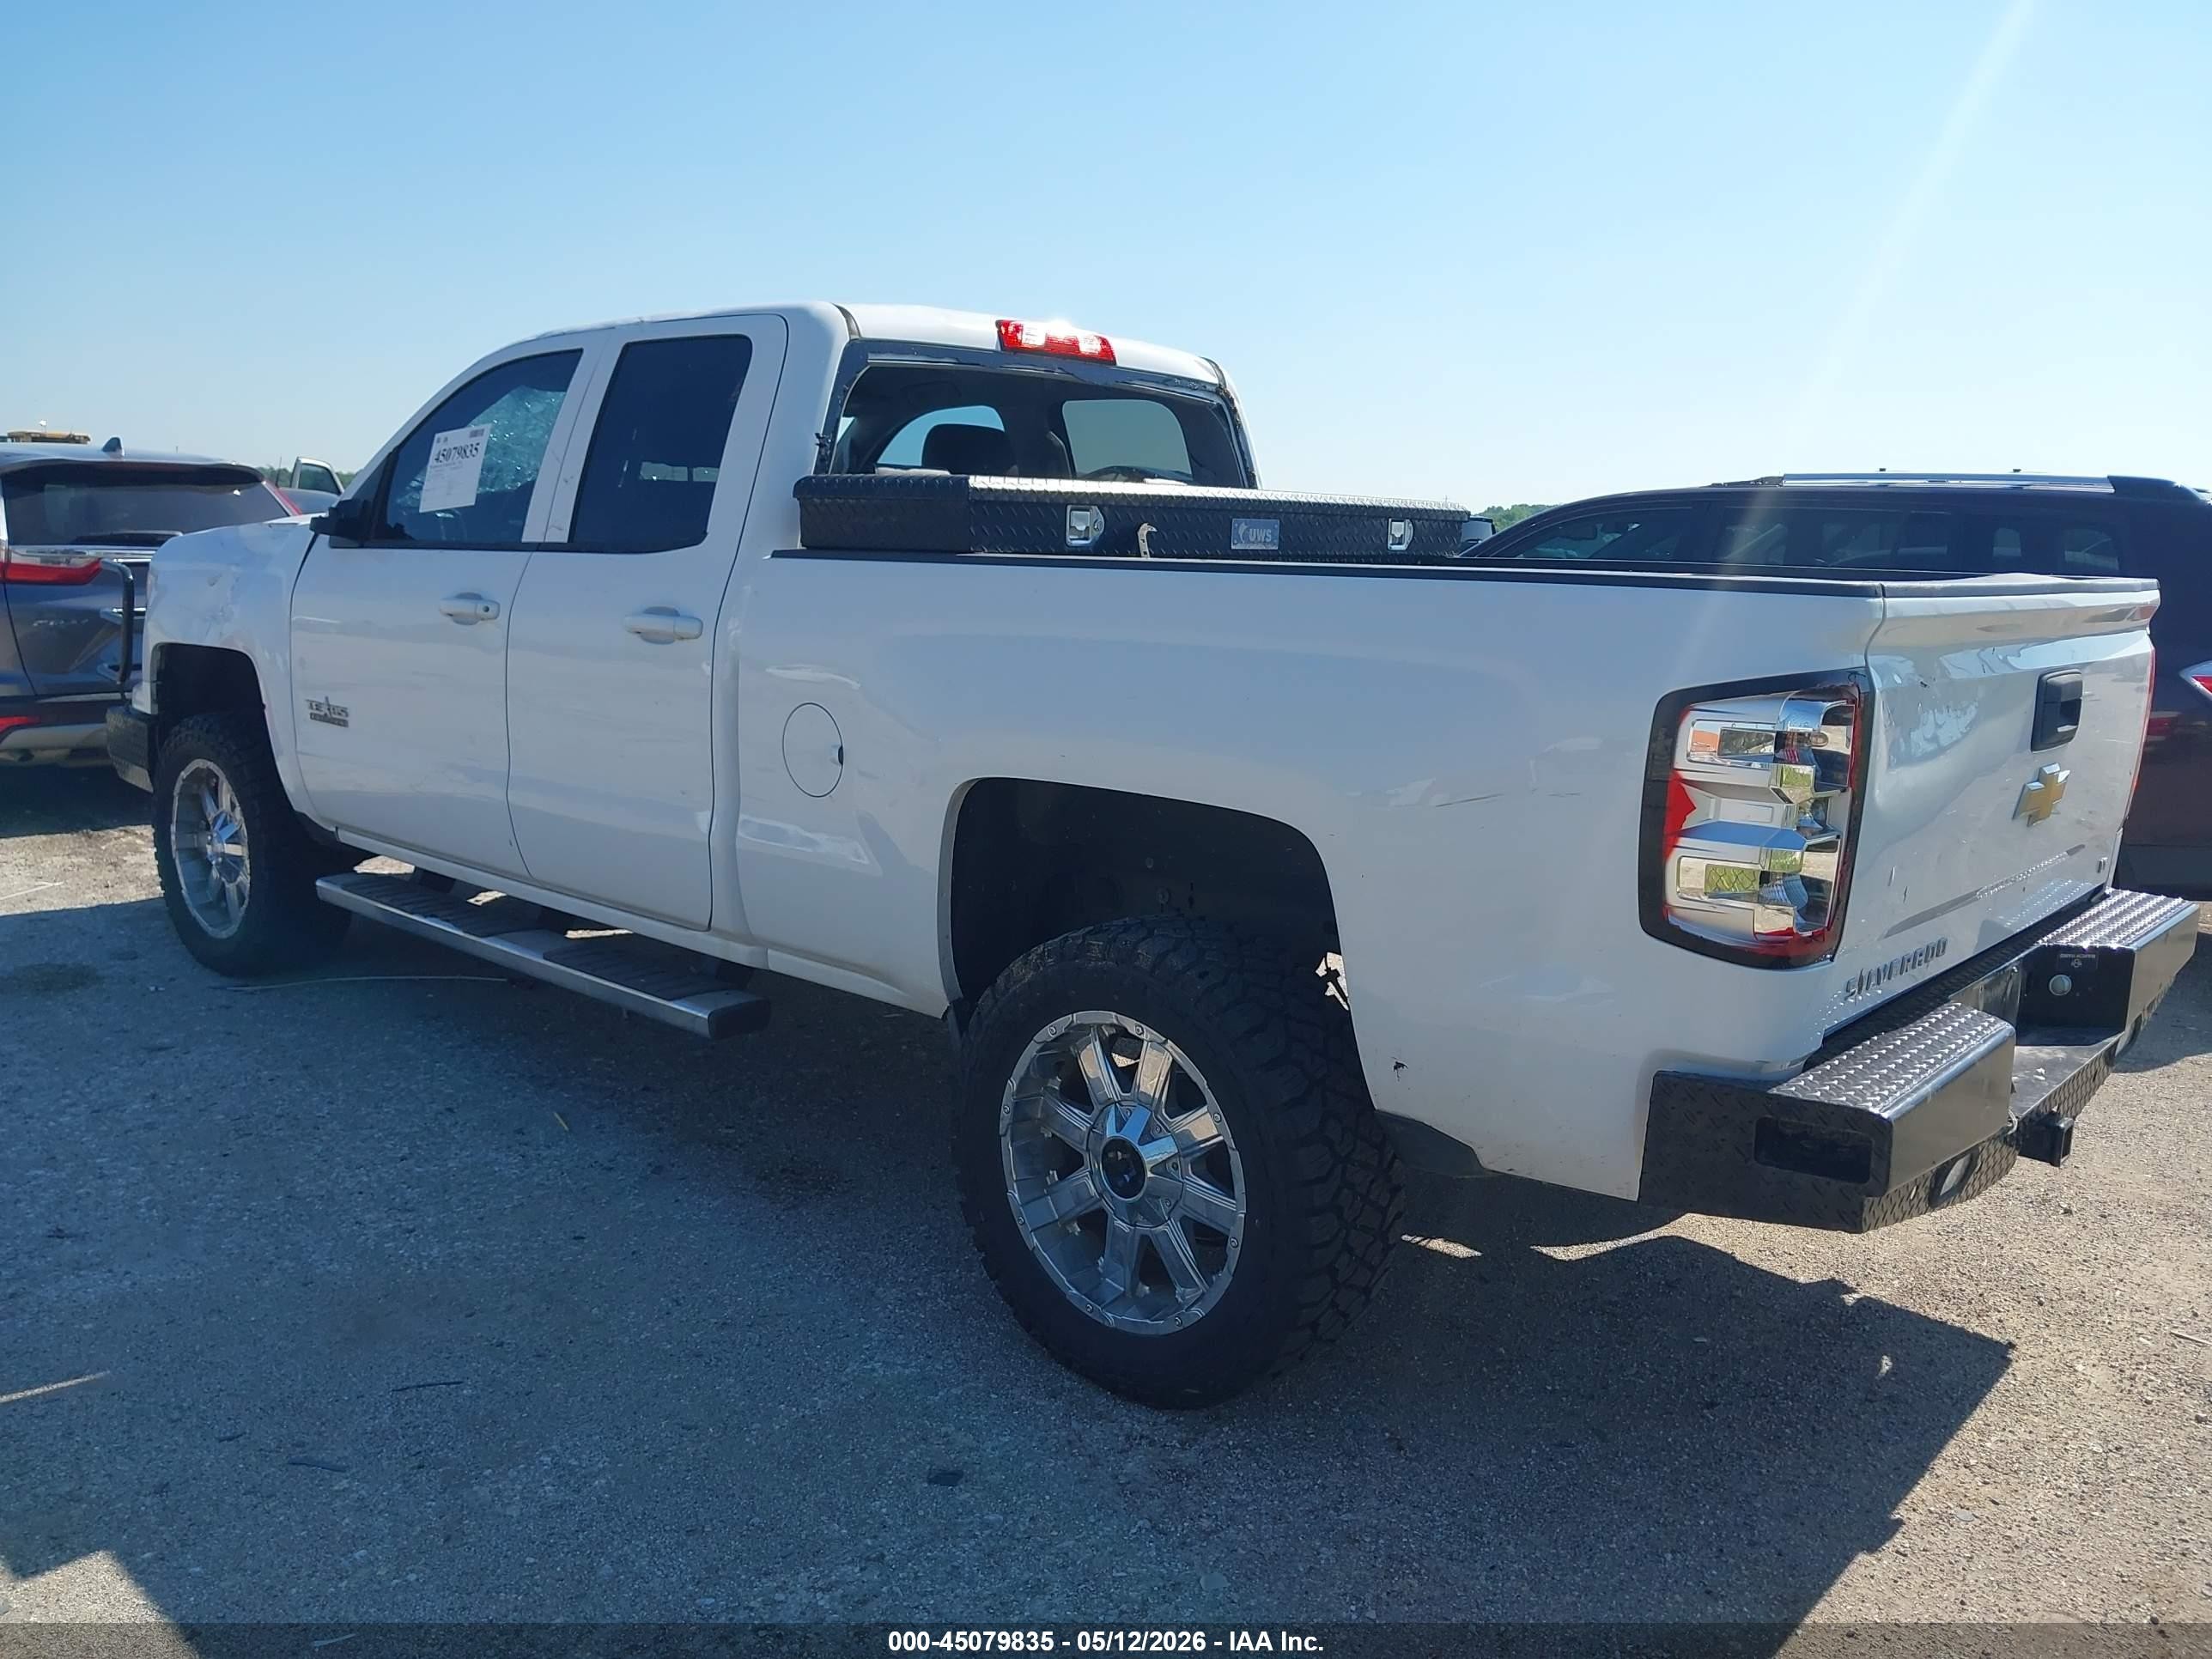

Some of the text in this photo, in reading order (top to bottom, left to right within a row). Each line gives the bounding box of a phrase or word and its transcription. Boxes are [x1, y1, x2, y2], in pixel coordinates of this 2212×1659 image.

[434, 442, 480, 464] 45079835
[1249, 528, 1272, 543] UWS
[1844, 937, 1948, 1000] SILVERADO
